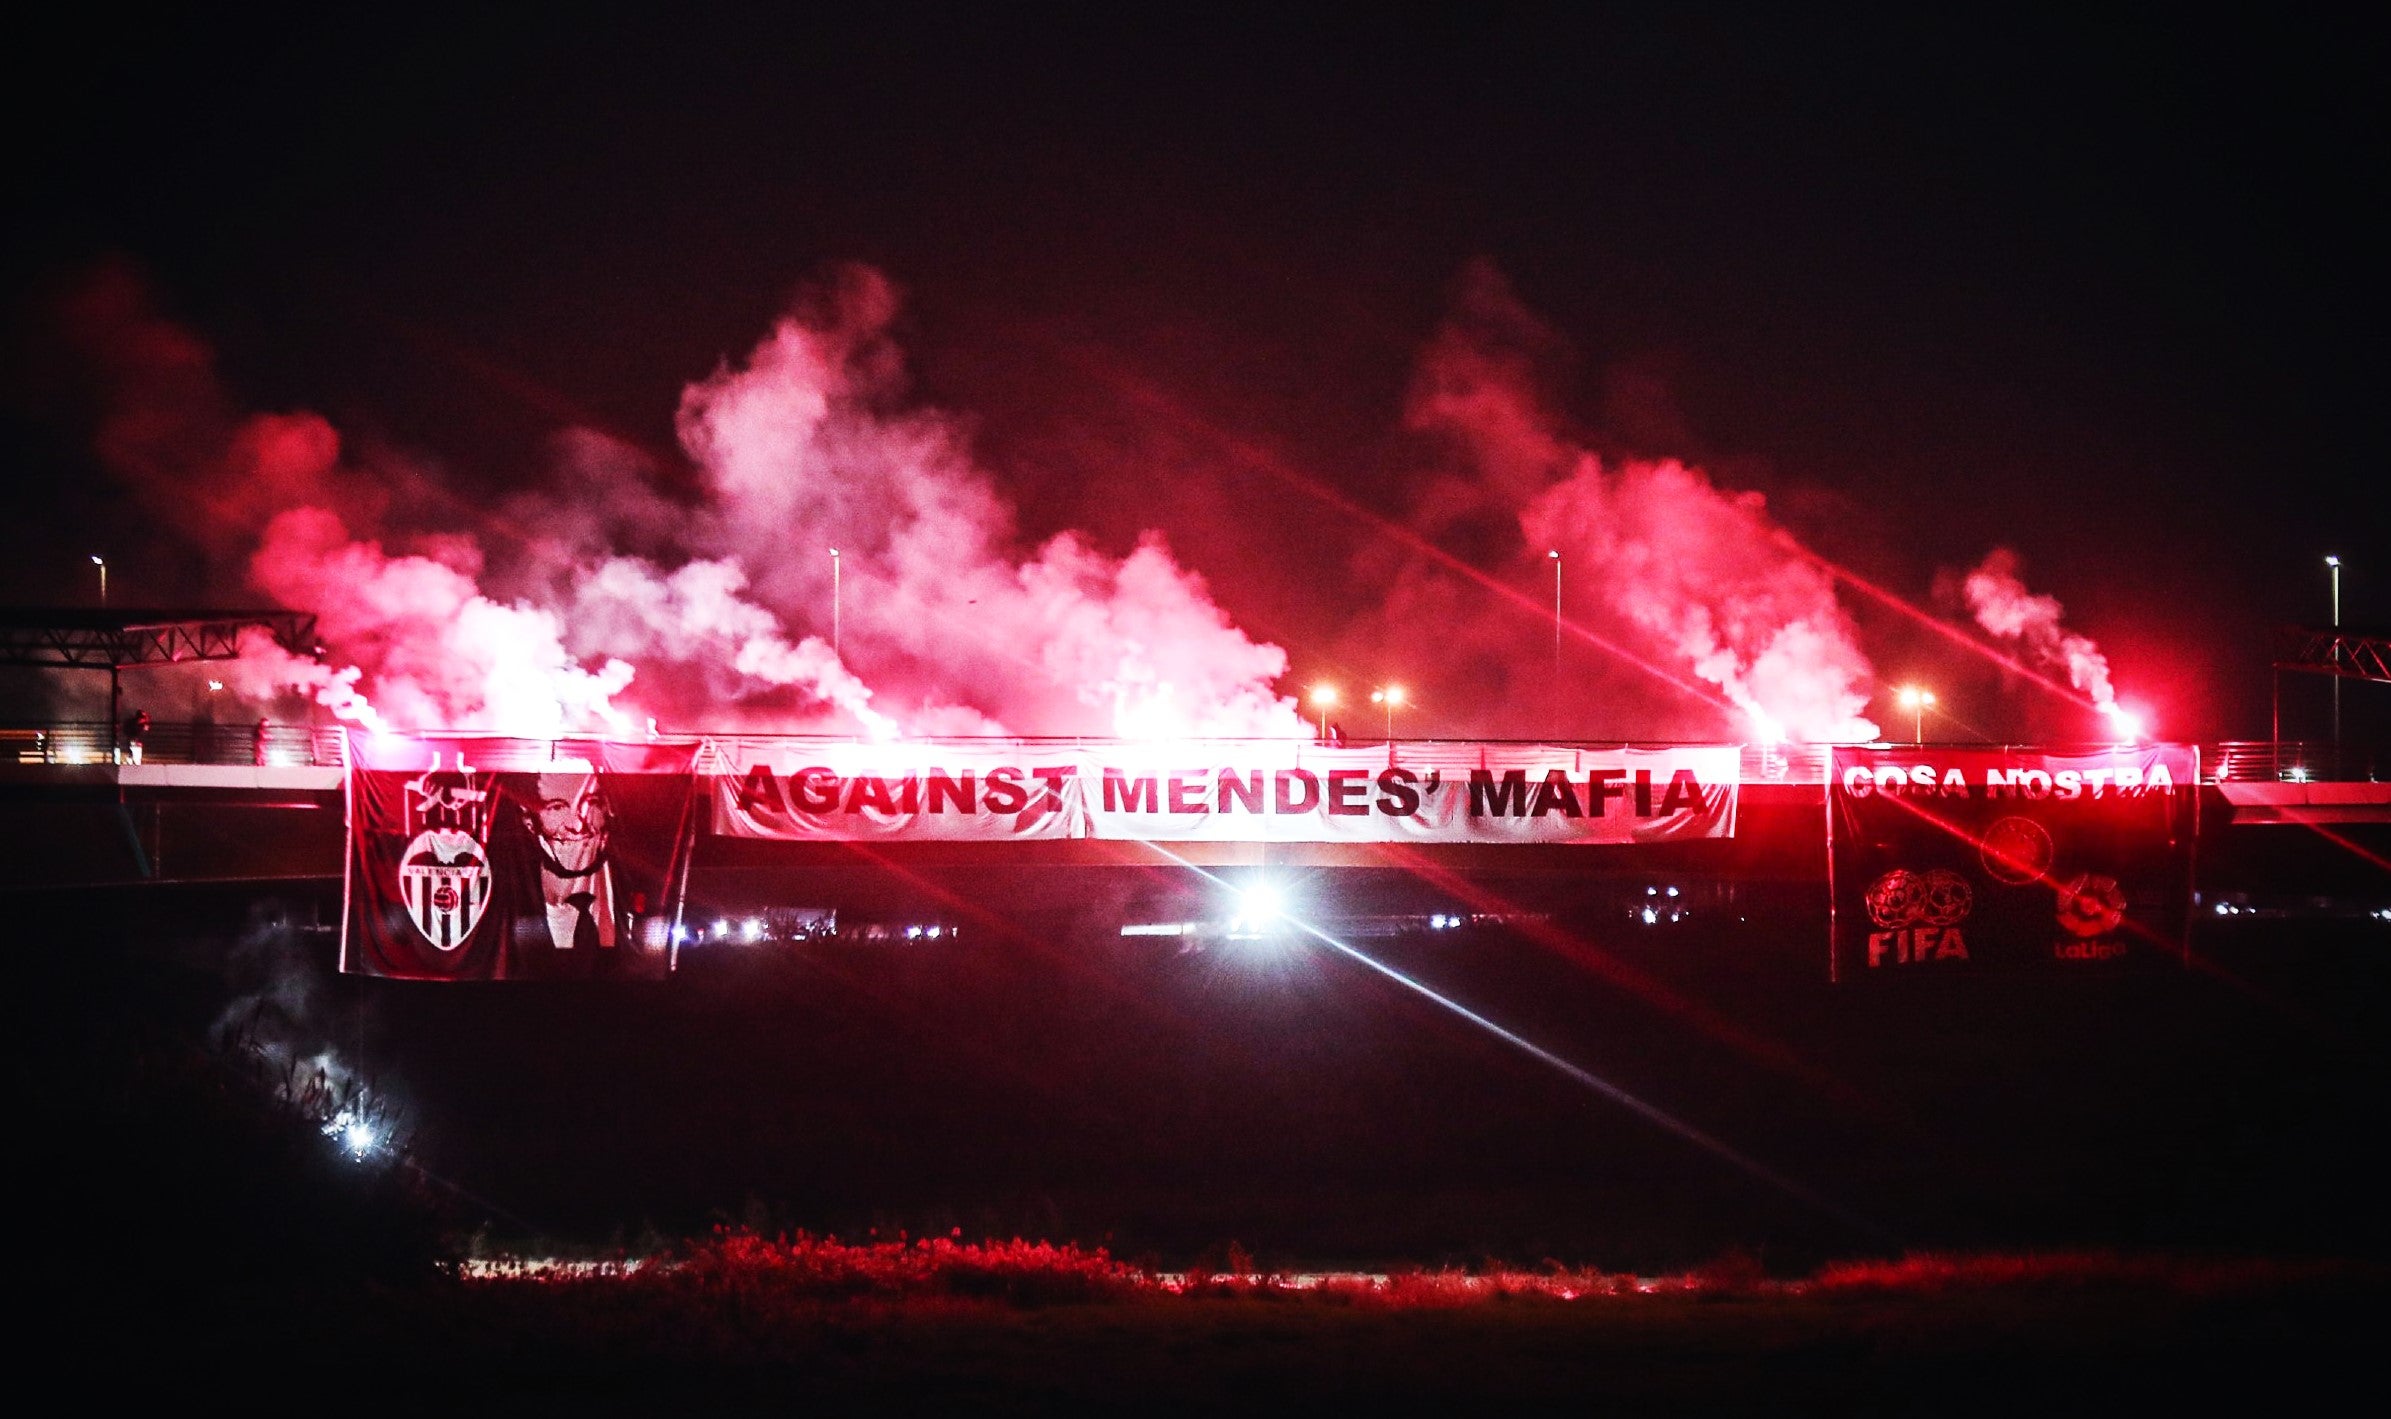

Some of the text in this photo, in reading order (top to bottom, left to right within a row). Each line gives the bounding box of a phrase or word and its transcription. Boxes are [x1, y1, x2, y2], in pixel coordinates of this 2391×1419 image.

[737, 764, 1706, 831] AGAINST MENDES' MAFIA
[1844, 765, 1969, 798] COSA
[1868, 928, 1969, 968] FIFA
